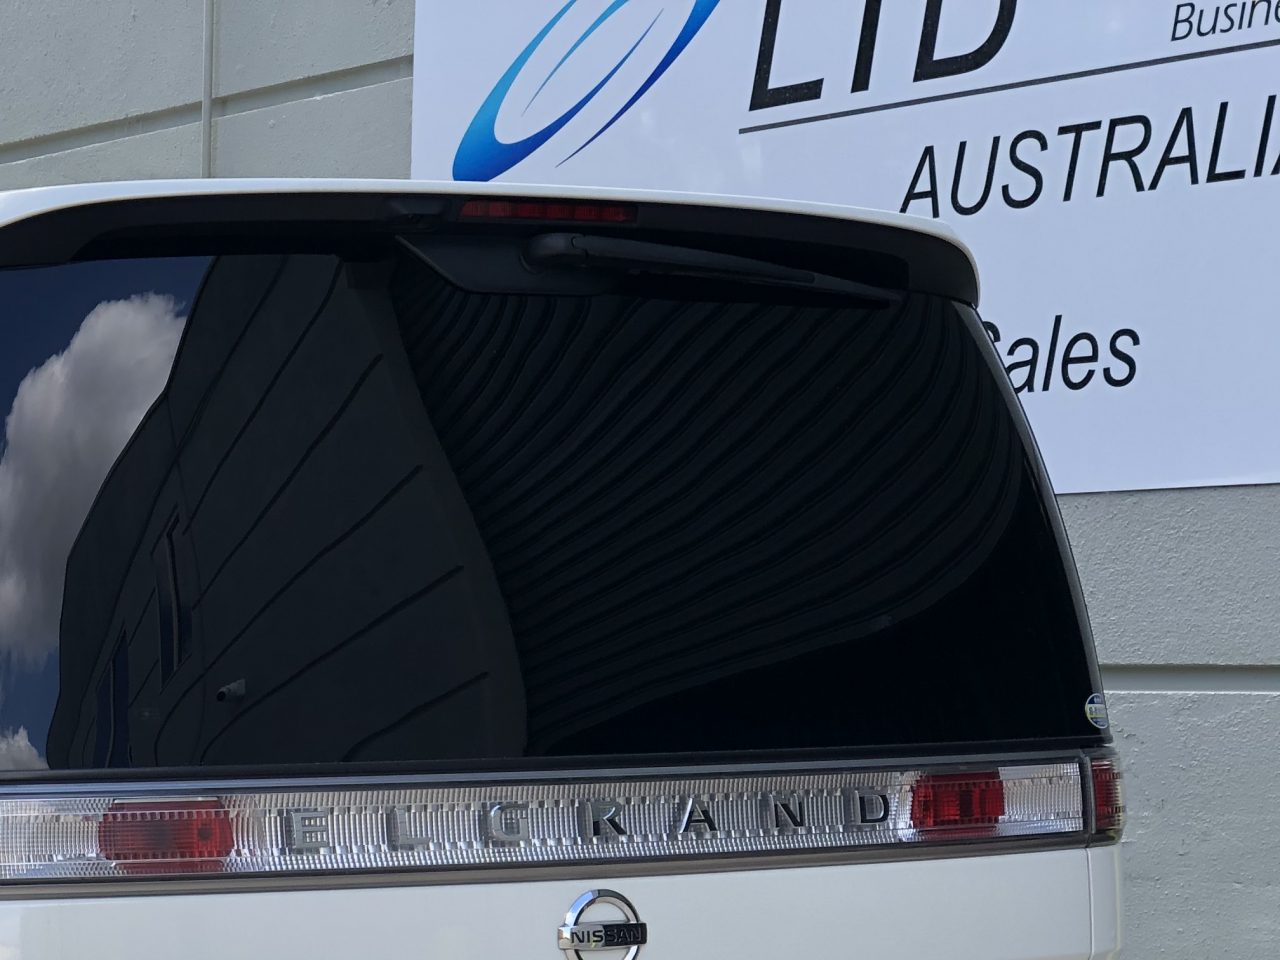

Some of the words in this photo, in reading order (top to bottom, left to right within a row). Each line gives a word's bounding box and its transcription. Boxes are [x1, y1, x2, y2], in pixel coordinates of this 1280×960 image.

[899, 94, 1280, 219] AUSTRALI
[291, 794, 890, 849] ELGRAND
[571, 927, 642, 944] NISSAN
